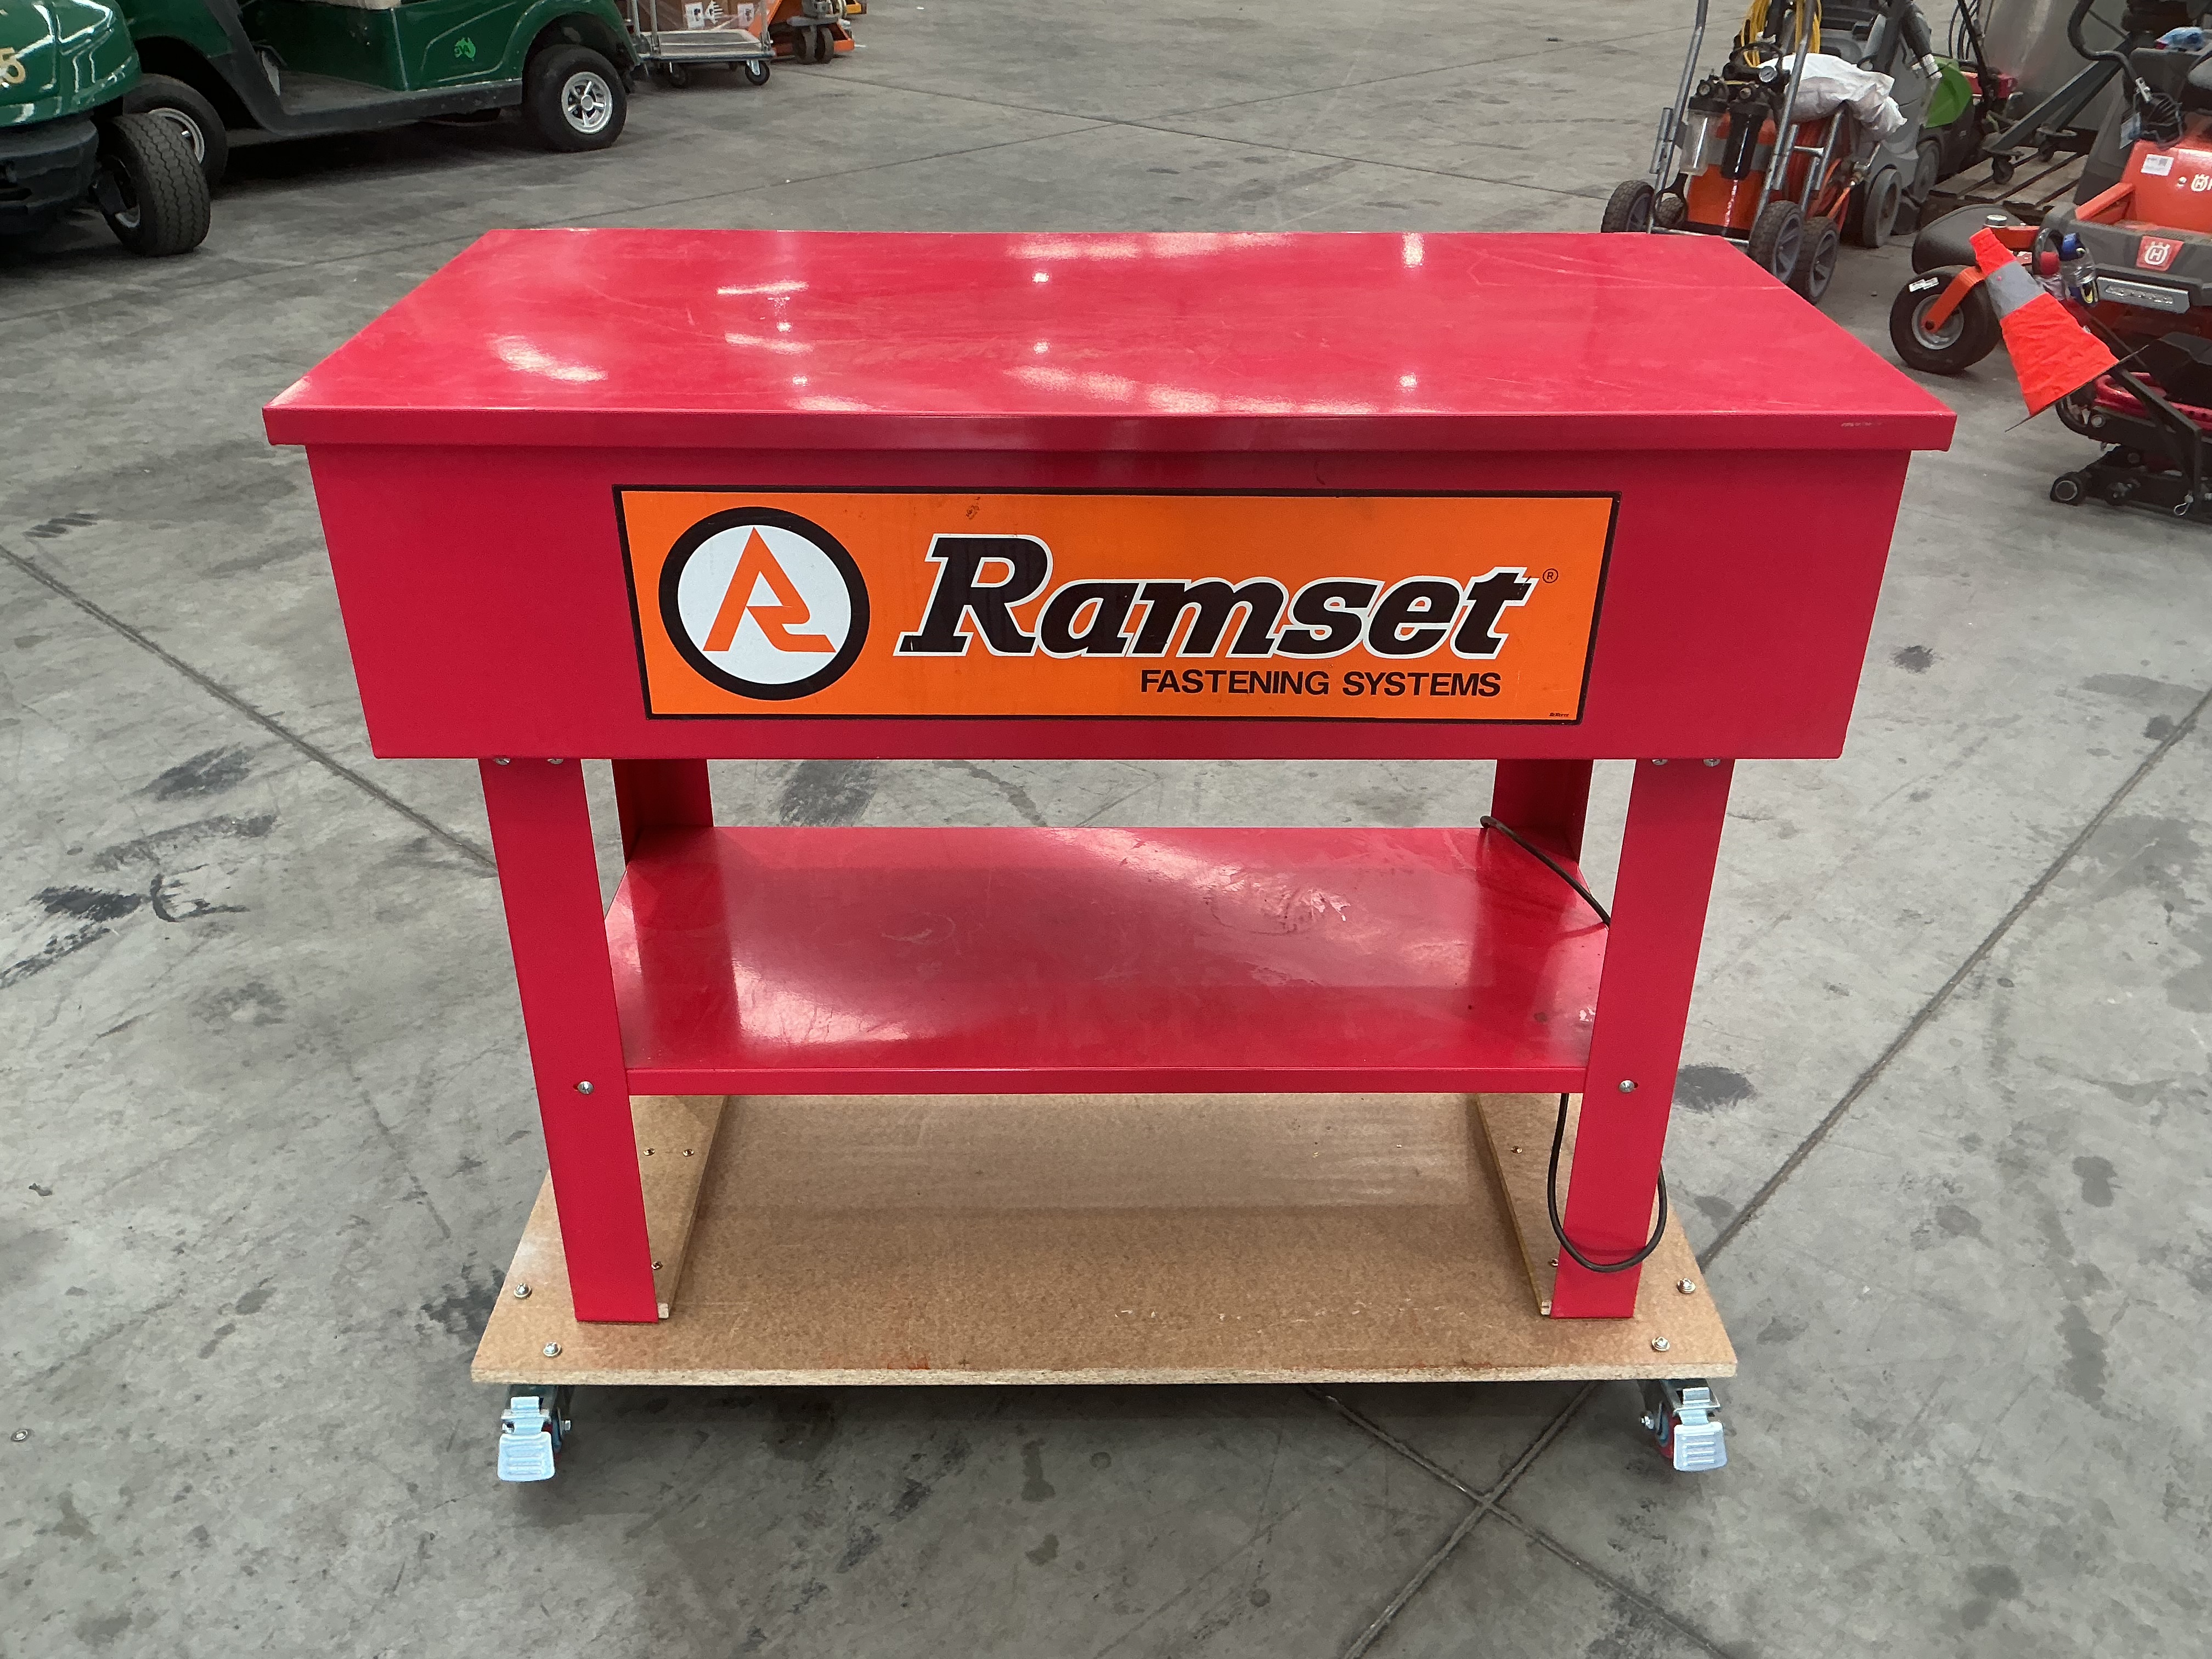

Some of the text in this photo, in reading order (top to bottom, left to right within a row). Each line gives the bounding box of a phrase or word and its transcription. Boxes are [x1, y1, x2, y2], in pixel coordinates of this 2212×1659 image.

[893, 533, 1539, 660] Ramset
[1141, 669, 1502, 697] FASTENING SYSTEMS
